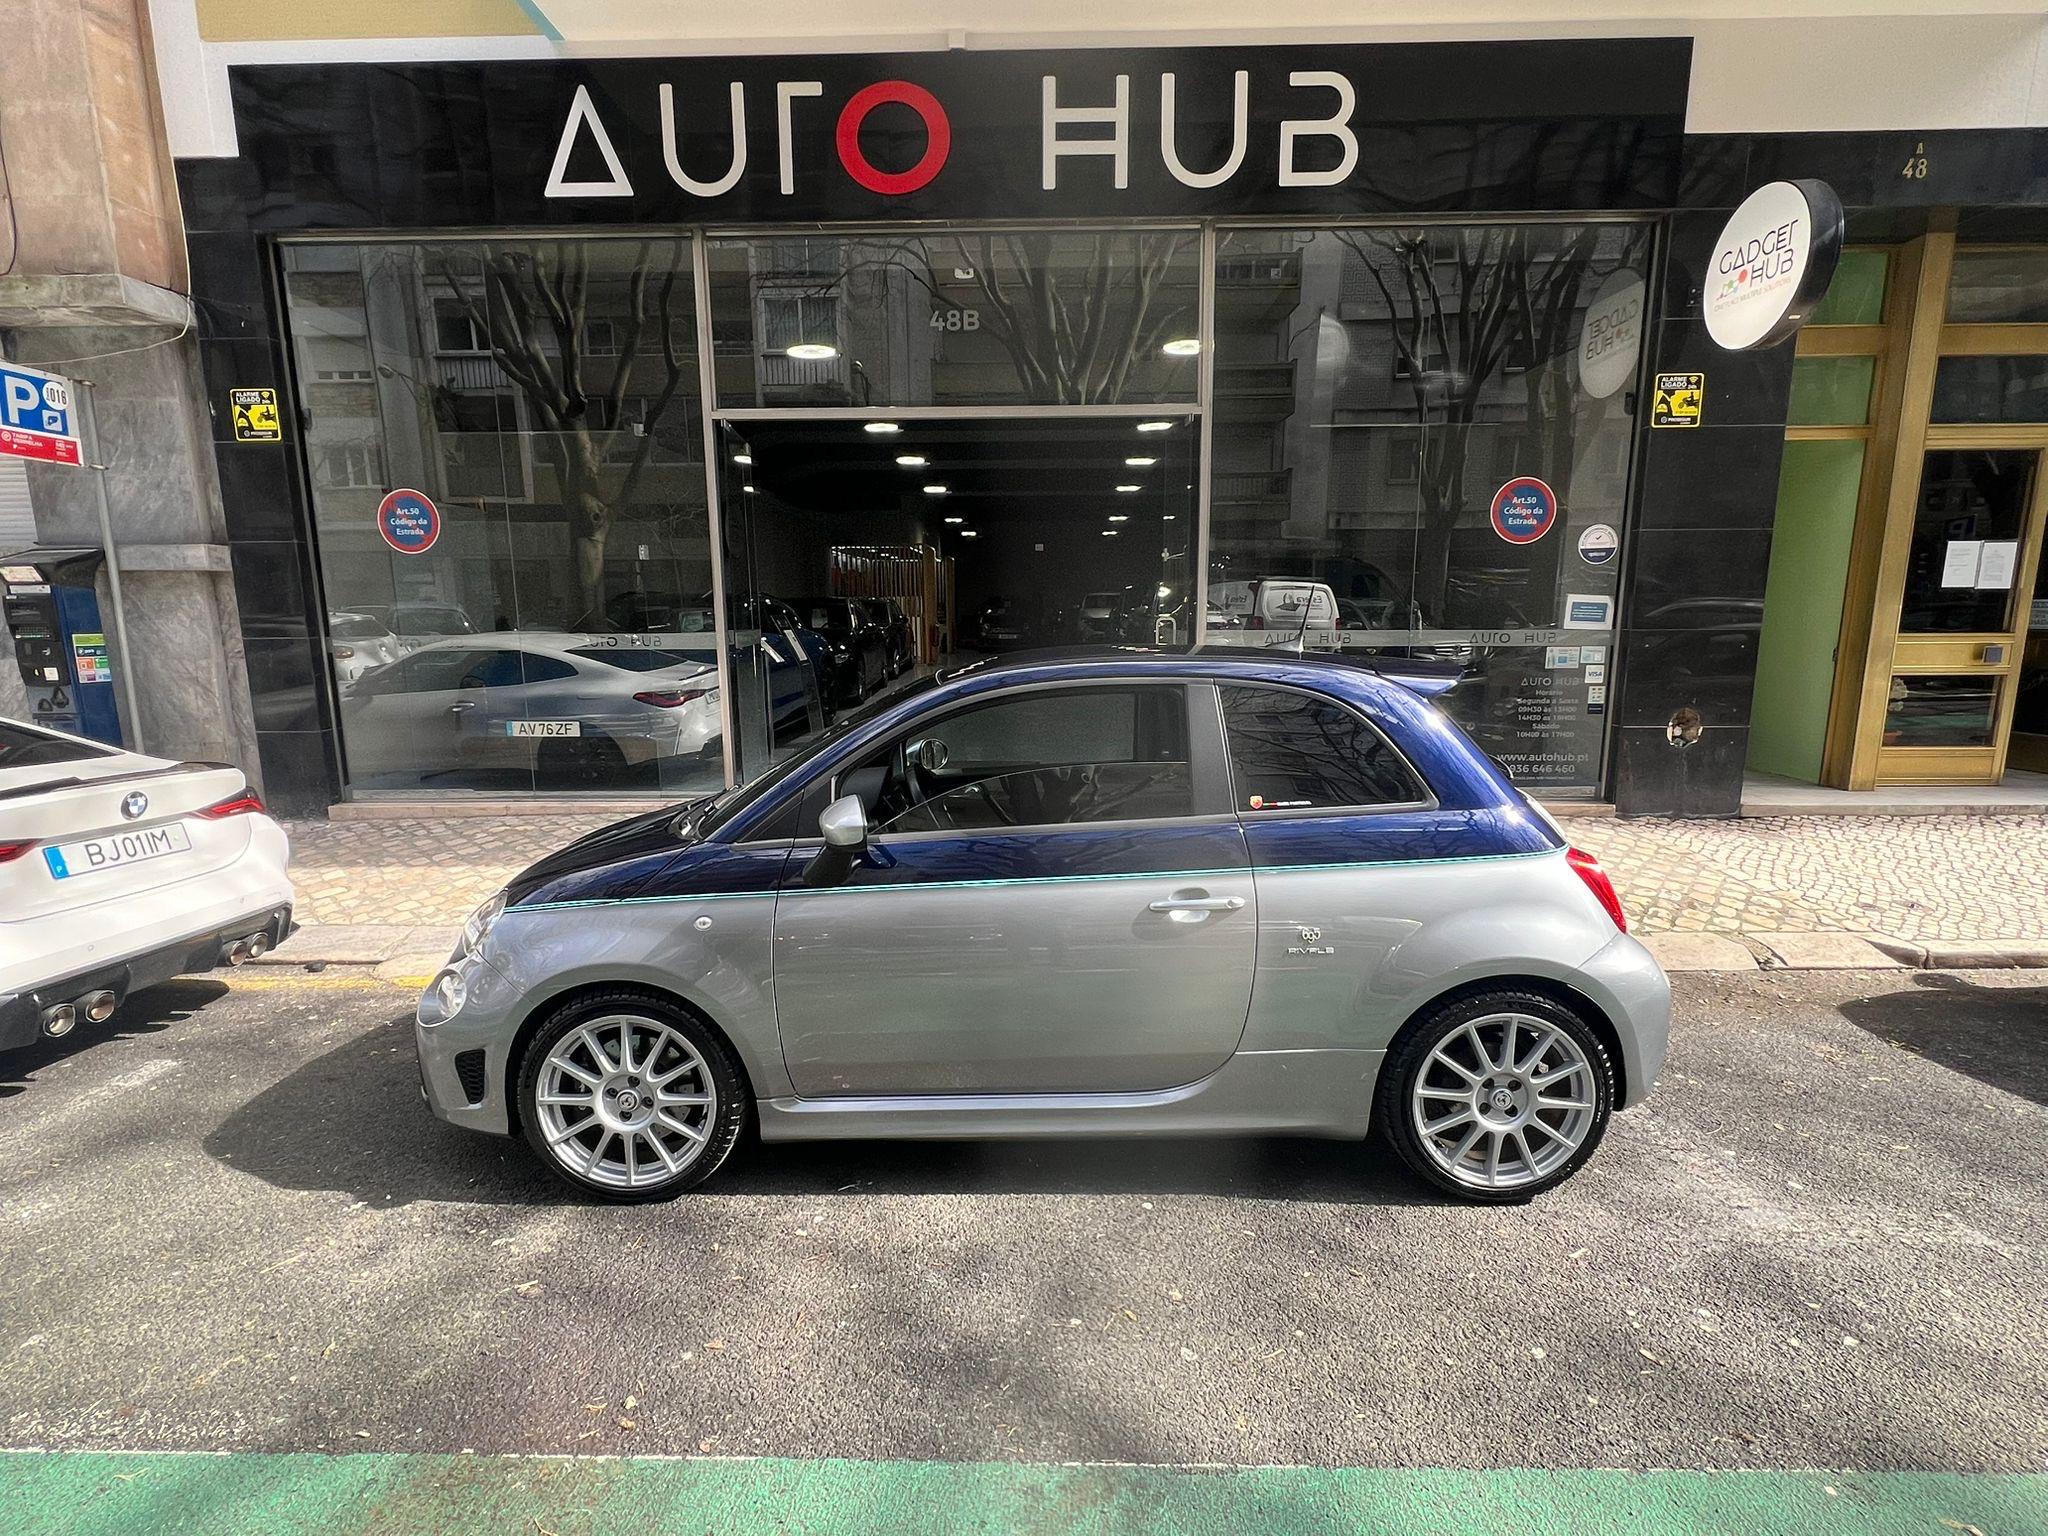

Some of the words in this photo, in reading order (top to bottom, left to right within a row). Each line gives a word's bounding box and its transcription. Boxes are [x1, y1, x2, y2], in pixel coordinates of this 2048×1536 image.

[543, 80, 951, 198] AUTO
[1042, 69, 1360, 192] HUB
[1901, 157, 1928, 179] 48
[1719, 218, 1799, 275] GADGET
[1749, 248, 1794, 288] HUB
[929, 309, 980, 332] 48B
[4, 375, 40, 424] P
[1511, 496, 1537, 504] Art.50
[396, 507, 420, 515] Art.50
[1503, 506, 1532, 516] Código
[1532, 506, 1544, 515] da
[390, 518, 417, 527] Código
[417, 517, 428, 525] da
[1507, 517, 1538, 525] Estrada
[1319, 632, 1352, 644] HUB
[1469, 632, 1511, 644] AUTO
[1524, 632, 1557, 643] HUB
[1521, 677, 1552, 686] AUTO
[518, 722, 573, 736] AV76ZF
[1497, 752, 1590, 763] www.autohub.pt
[1509, 763, 1530, 774] 936
[1532, 763, 1553, 774] 646
[1555, 763, 1576, 774] 460
[84, 829, 173, 867] BJ01IM
